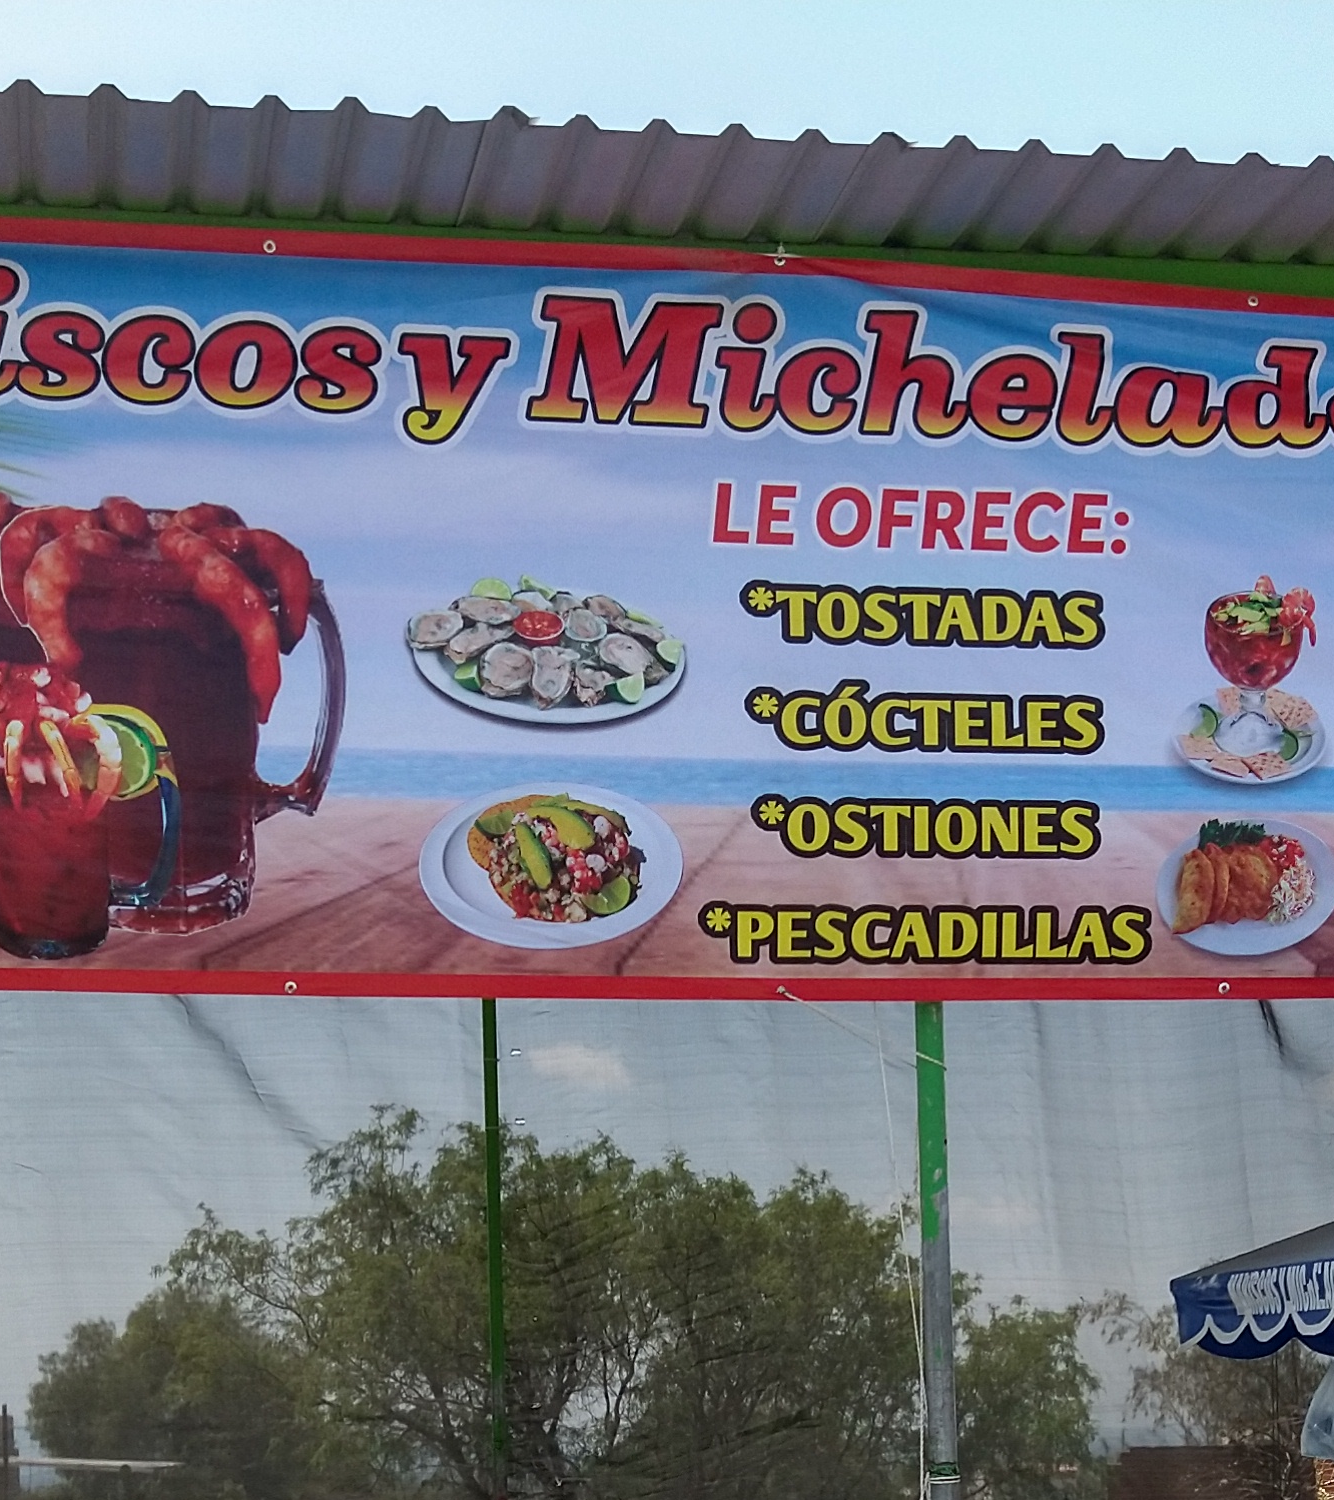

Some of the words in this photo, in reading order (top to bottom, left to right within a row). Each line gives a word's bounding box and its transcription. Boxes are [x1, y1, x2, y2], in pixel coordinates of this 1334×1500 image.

[398, 335, 514, 445] y
[712, 482, 797, 546] LE
[815, 486, 1130, 555] OFRECE:
